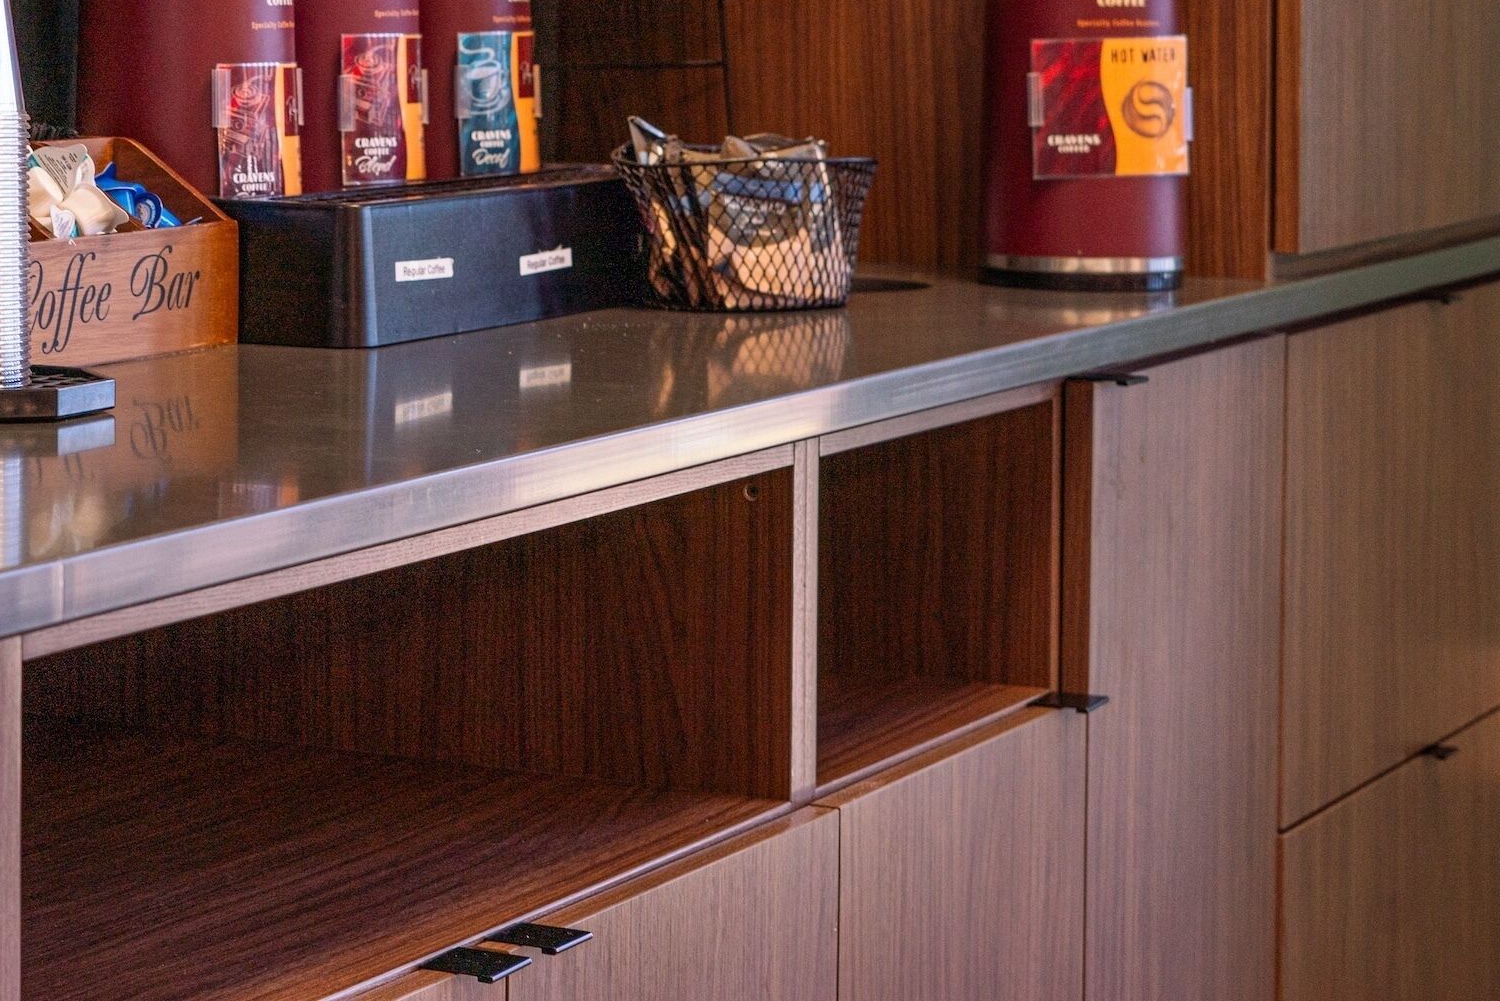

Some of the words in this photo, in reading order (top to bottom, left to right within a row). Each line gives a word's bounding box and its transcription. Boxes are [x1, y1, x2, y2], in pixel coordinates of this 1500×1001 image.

[1111, 48, 1134, 63] HOT
[1142, 47, 1176, 63] WATER
[471, 129, 512, 141] CRAVENS
[1047, 134, 1101, 146] CRAVENS
[354, 137, 398, 148] CRAVENS
[527, 259, 547, 270] Regular
[548, 256, 565, 266] Coffee
[403, 265, 426, 277] Regular
[428, 264, 445, 274] Coffee
[130, 244, 200, 321] Bar
